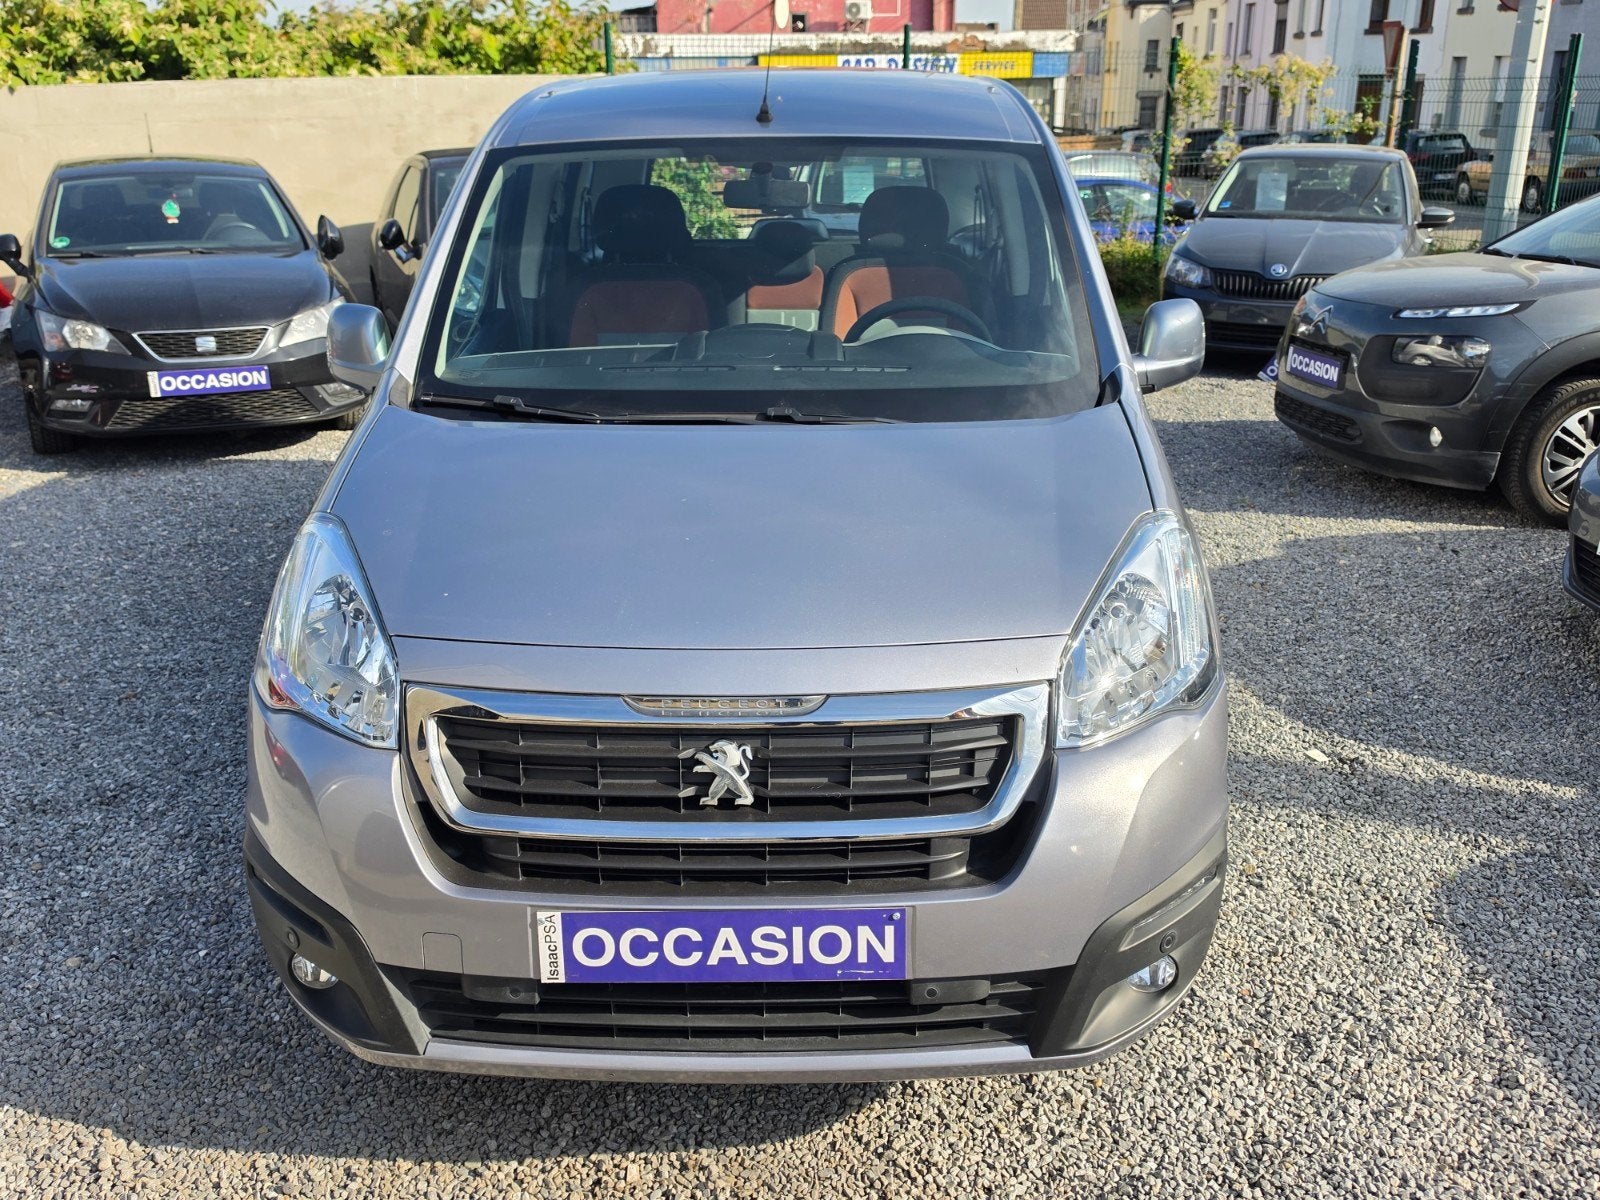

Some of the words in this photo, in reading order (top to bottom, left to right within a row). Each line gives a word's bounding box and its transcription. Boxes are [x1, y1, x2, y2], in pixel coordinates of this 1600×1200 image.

[887, 57, 956, 73] DSIGN
[972, 60, 1015, 71] SERVICE
[1291, 353, 1339, 382] OCCASION
[161, 371, 267, 391] OCCASION
[661, 699, 784, 710] PEUGEOT
[546, 914, 560, 982] IsaacPSA
[572, 925, 895, 967] OCCASION
